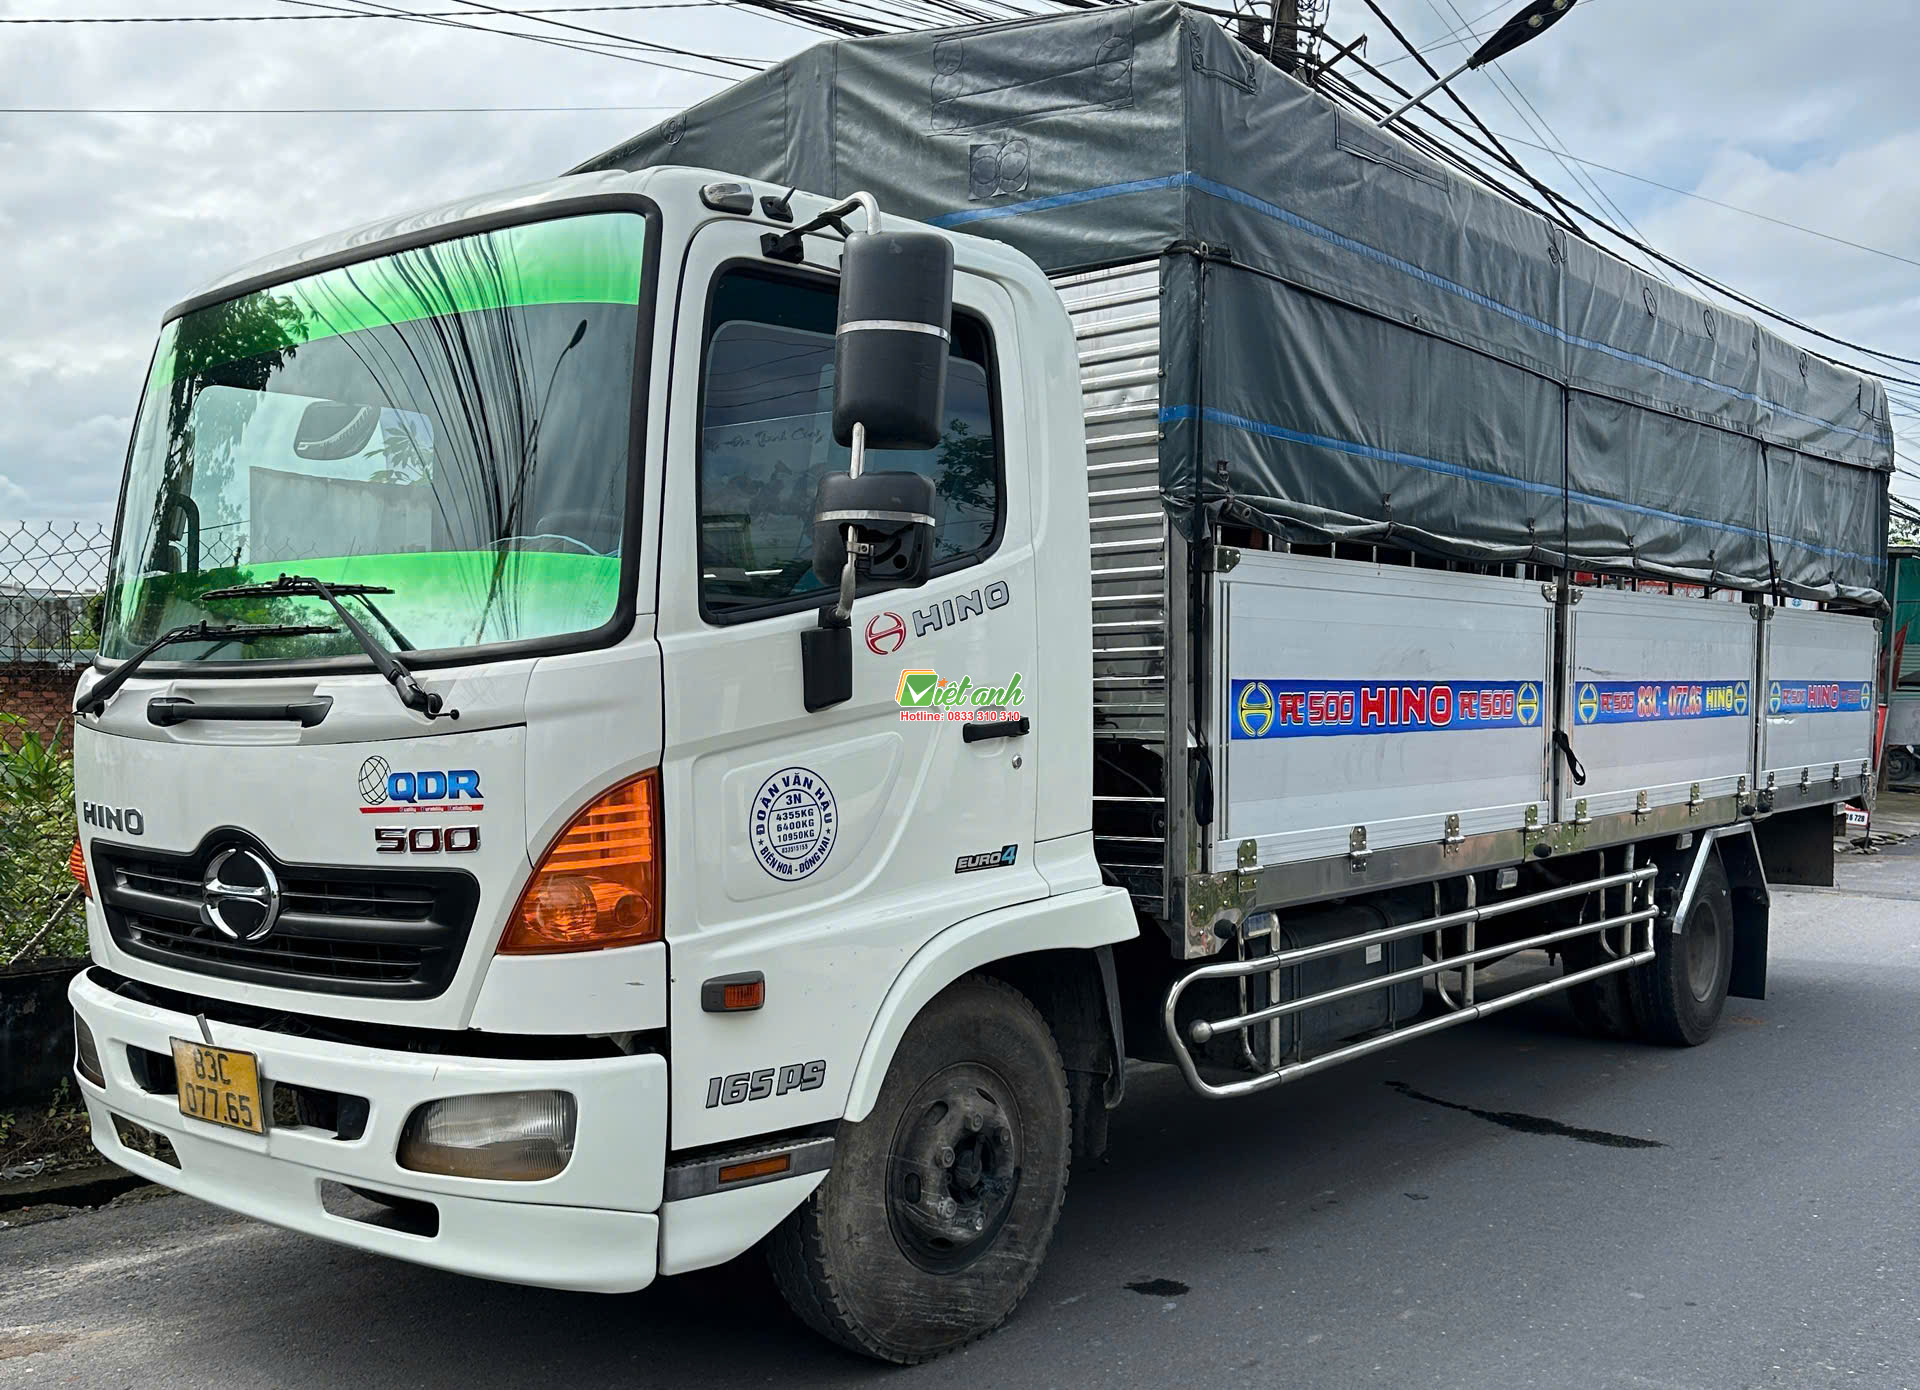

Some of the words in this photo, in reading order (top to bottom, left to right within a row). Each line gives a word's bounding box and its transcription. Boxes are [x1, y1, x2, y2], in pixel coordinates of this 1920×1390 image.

[912, 580, 1010, 637] HINO
[1308, 691, 1355, 725] 500
[1360, 685, 1452, 727] HINO
[1479, 689, 1515, 720] 500
[1613, 691, 1635, 714] 500
[1637, 685, 1661, 718] 83C
[1706, 686, 1733, 711] HINO
[1807, 684, 1839, 709] HINO
[387, 769, 484, 804] QDR
[786, 793, 802, 805] 3N
[83, 800, 144, 836] HINO
[776, 808, 814, 821] 4355KG
[776, 818, 815, 832] 6400KG
[374, 824, 481, 855] 500
[777, 829, 815, 843] 10950KG
[817, 836, 831, 853] NAI
[193, 1048, 231, 1085] 83C
[185, 1082, 252, 1127] 077.65
